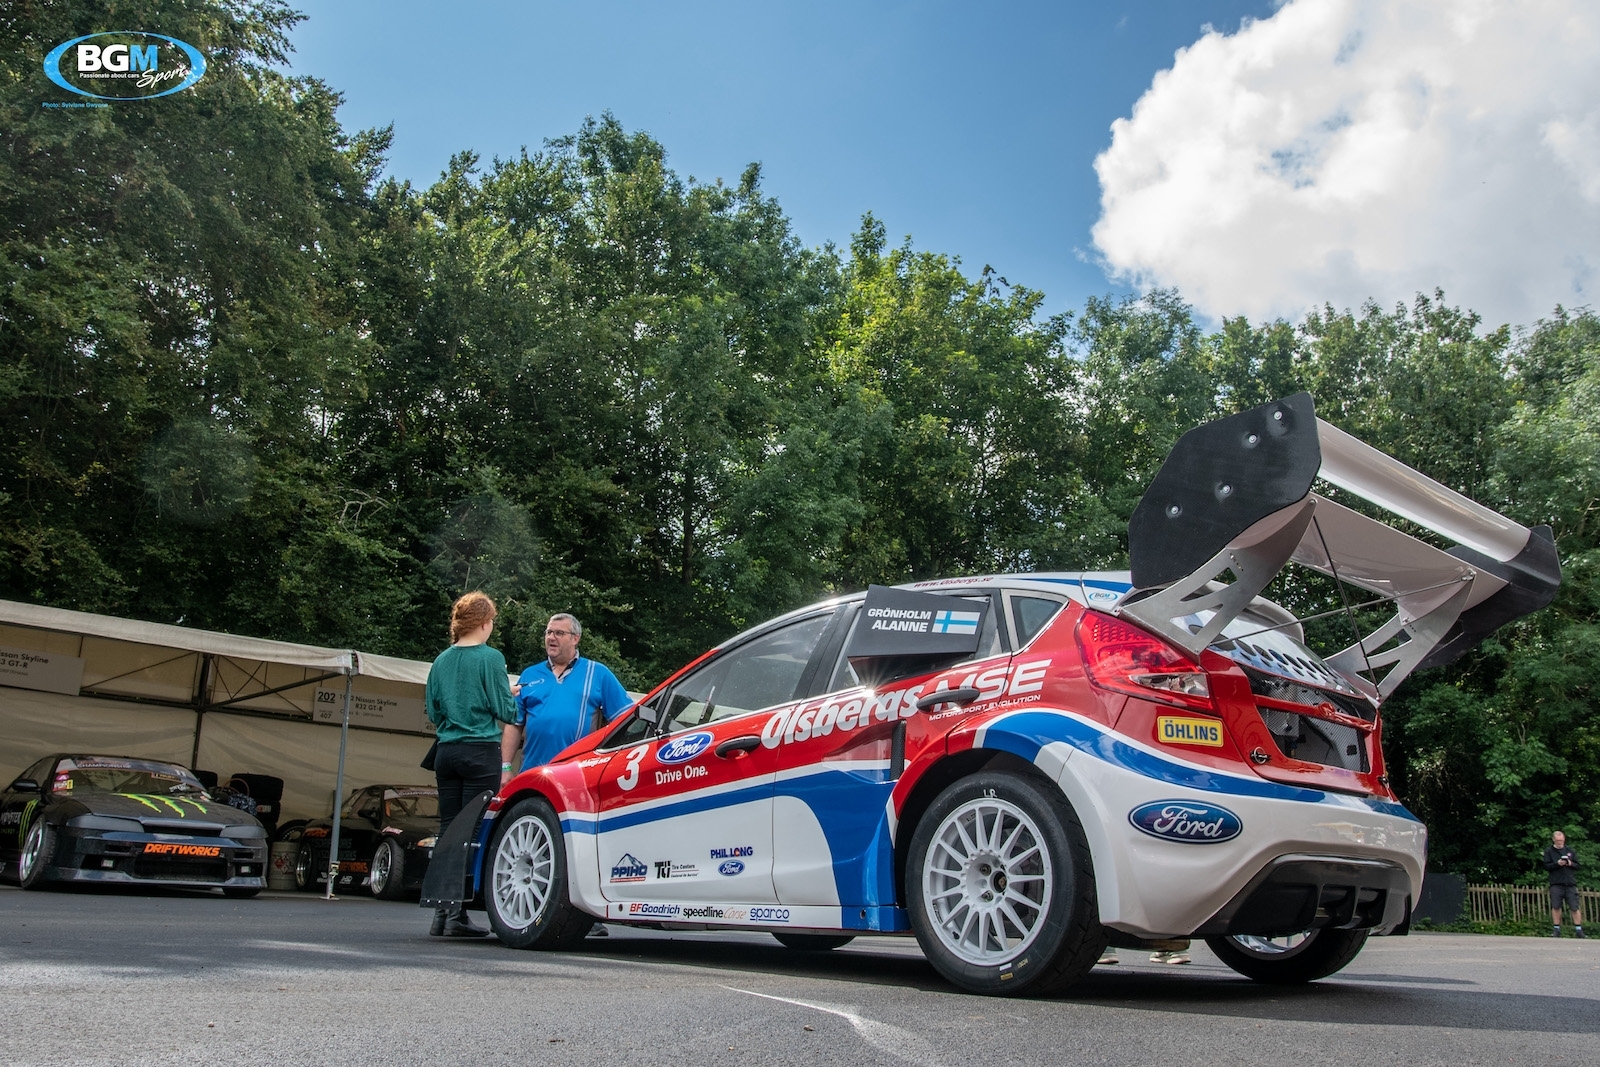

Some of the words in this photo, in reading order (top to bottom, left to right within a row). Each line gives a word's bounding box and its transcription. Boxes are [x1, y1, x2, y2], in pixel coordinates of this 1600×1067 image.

[867, 607, 931, 620] GRÖNHOLM
[871, 619, 928, 633] ALANNE
[8, 659, 29, 669] GT-R
[21, 653, 49, 664] Skyline
[318, 691, 336, 701] 202
[356, 696, 376, 704] Nissan
[376, 699, 398, 707] Skyline
[929, 704, 988, 721] MOTORSPORT
[988, 695, 1041, 709] EVOLUTION
[1164, 720, 1218, 741] ÖHLINS
[664, 735, 704, 760] Ford
[617, 744, 649, 791] 3
[655, 768, 682, 785] Drive
[684, 765, 708, 779] One.
[983, 788, 998, 798] LR
[1153, 805, 1224, 838] Ford
[144, 843, 220, 857] DRIFTWORKS
[710, 848, 728, 859] PHIL
[730, 846, 753, 857] LONG
[629, 903, 680, 915] BFGoodrich
[683, 906, 724, 919] speedline
[724, 907, 747, 919] Corse
[750, 908, 790, 921] sparco
